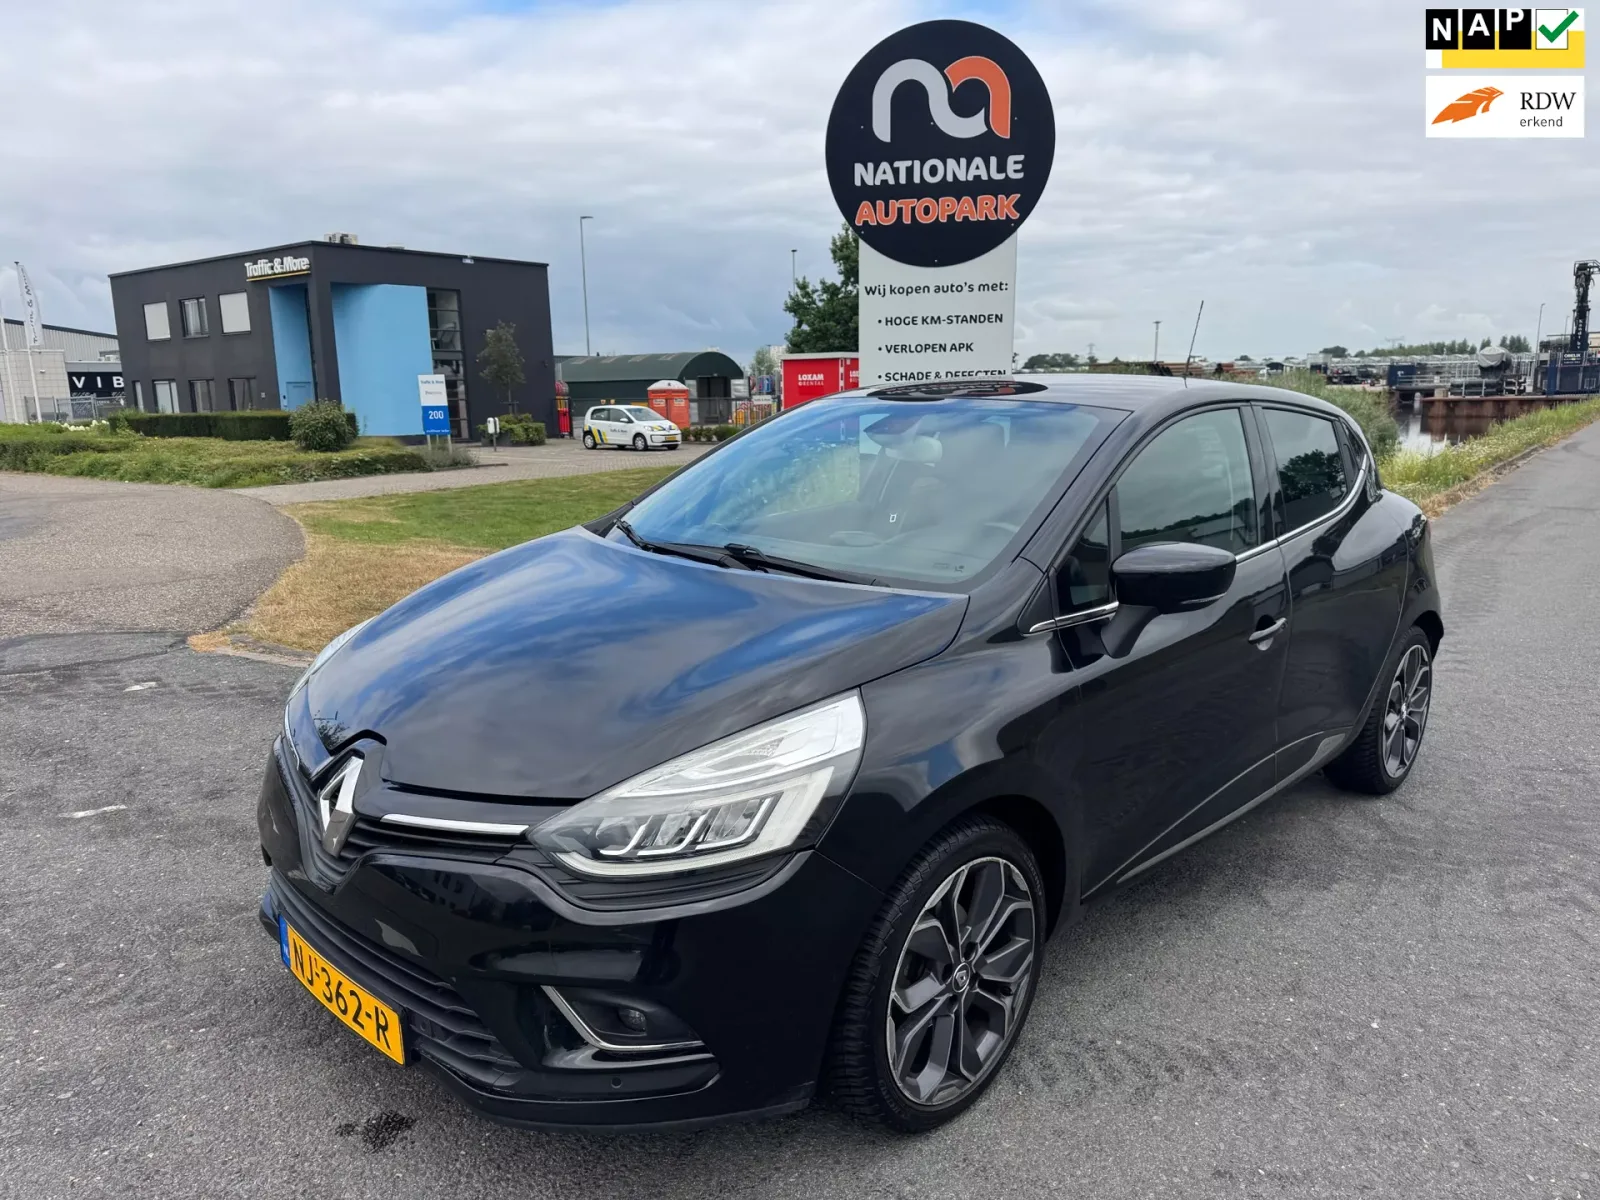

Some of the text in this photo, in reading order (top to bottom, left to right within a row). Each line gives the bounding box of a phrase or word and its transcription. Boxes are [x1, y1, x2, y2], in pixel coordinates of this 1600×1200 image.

[854, 154, 1025, 186] NATIONALE
[855, 193, 1021, 226] AUTOPARK
[244, 256, 310, 277] Traffic & More
[864, 281, 1009, 298] Wij kopen auto's met:
[885, 313, 1004, 326] HOGE KM-STANDEN
[885, 342, 974, 354] VERLOPEN APK
[798, 373, 824, 381] LOXAM
[884, 371, 932, 382] SCHADE
[428, 411, 444, 420] 200
